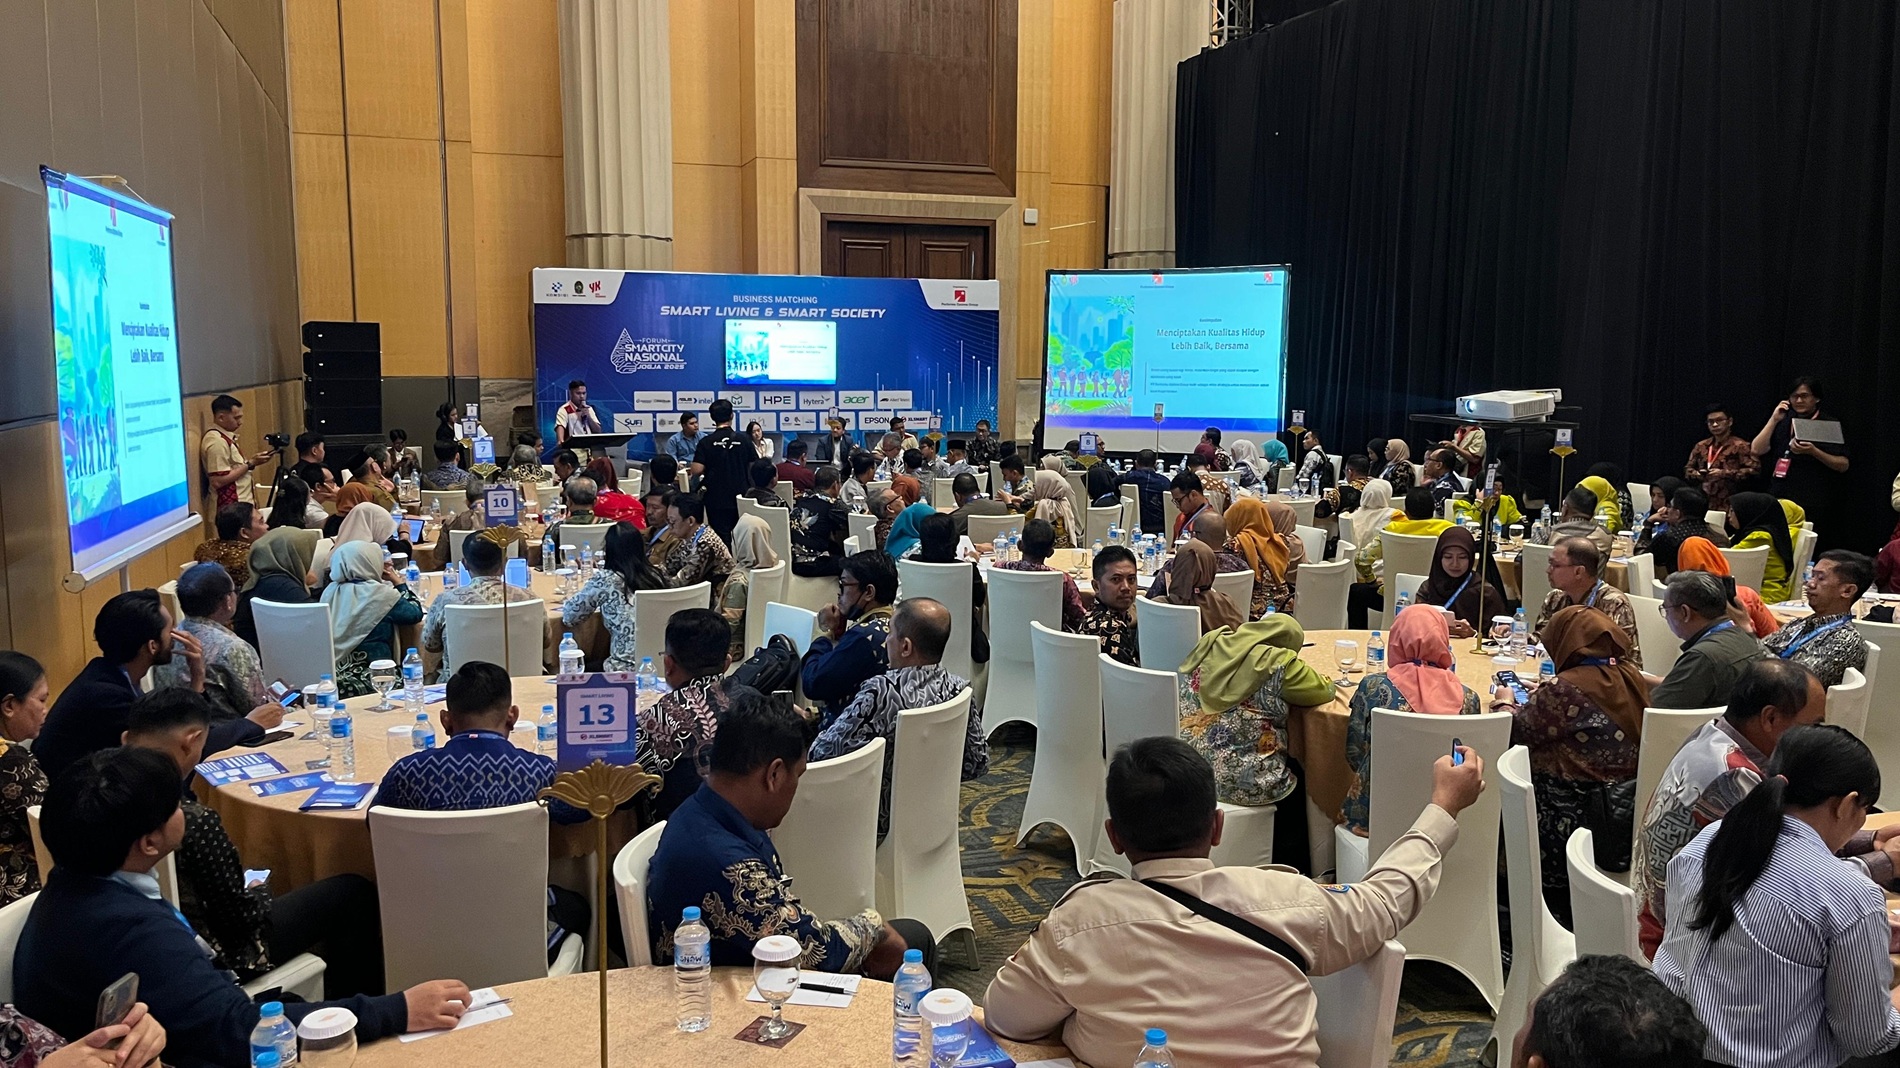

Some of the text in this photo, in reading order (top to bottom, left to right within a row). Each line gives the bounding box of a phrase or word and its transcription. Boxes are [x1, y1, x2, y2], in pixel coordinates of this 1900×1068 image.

[733, 295, 818, 304] BUSINESS MATCHING
[660, 306, 886, 318] SMART LIVING & SMART SOCIETY
[1156, 328, 1266, 338] Menciptakan Kualitas Hidup
[625, 344, 684, 352] SMARTCITY
[1171, 342, 1249, 351] Lebih Baik, Bersama
[625, 353, 684, 362] NASIONAL
[763, 396, 791, 404] HPE
[843, 396, 870, 404] acer
[493, 497, 509, 508] 10
[579, 704, 615, 726] 13
